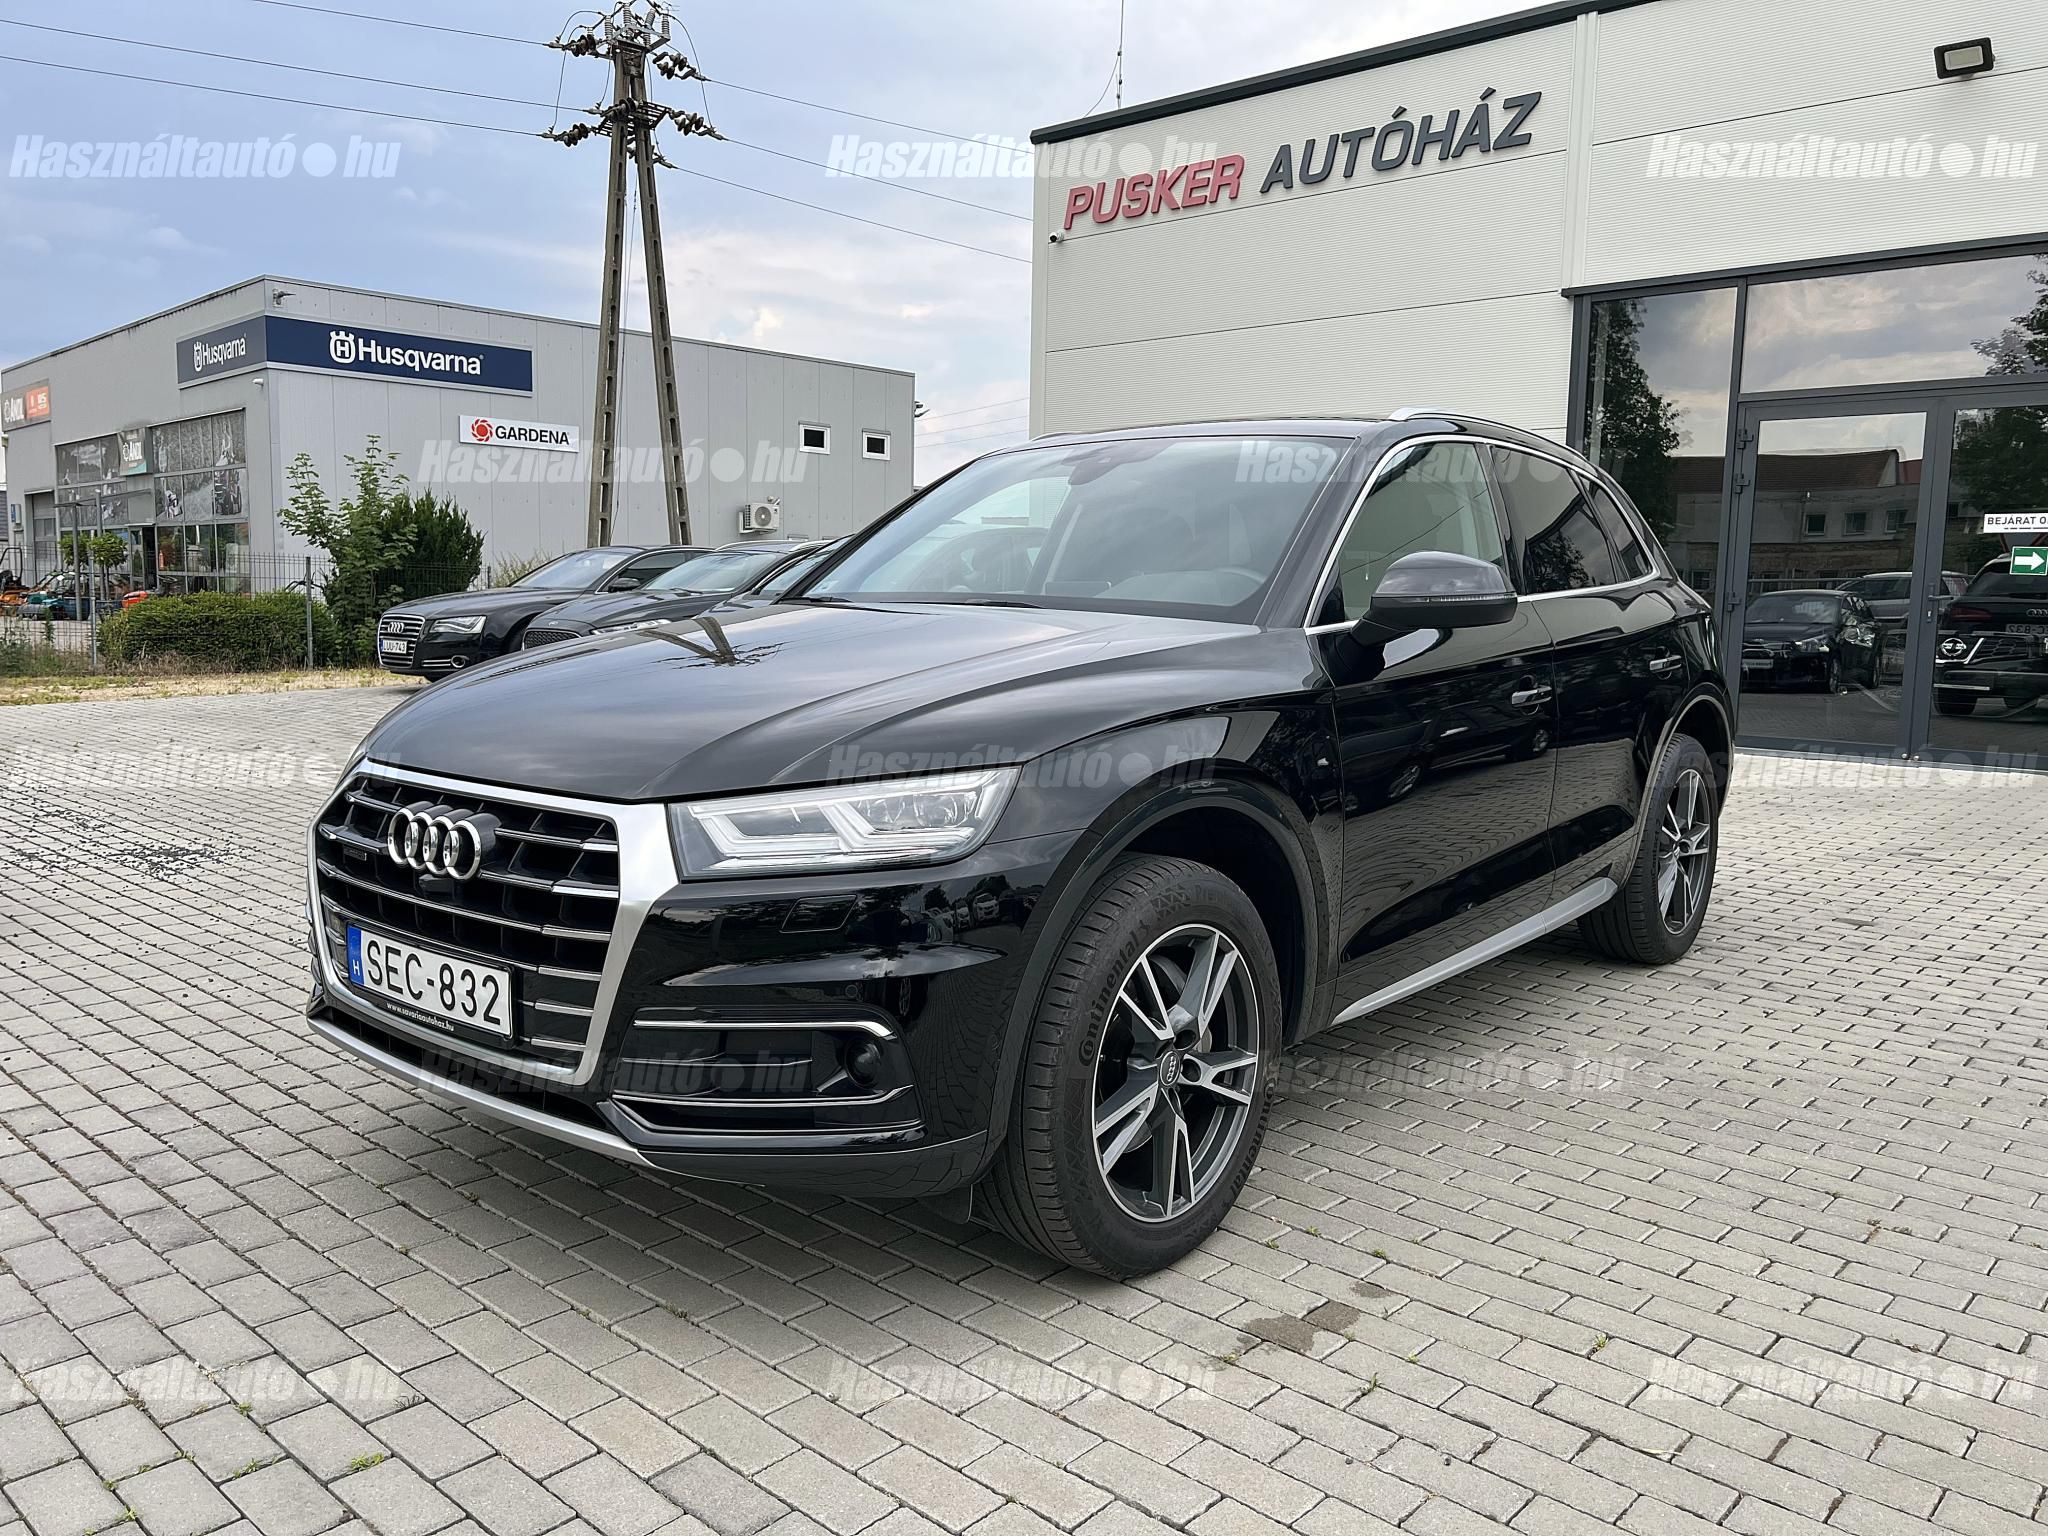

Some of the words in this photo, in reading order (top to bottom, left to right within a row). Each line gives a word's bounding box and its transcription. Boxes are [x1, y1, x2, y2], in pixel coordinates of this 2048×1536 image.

[1063, 153, 1245, 230] PUSKER
[1260, 87, 1542, 193] AUTÓHÁZ
[203, 335, 246, 366] Husqvarna
[358, 338, 482, 375] Husqvarna
[495, 425, 570, 446] GARDENA
[1987, 514, 2036, 525] BEJÁRAT
[352, 960, 361, 976] H
[367, 939, 501, 1026] SEC-832
[1078, 930, 1142, 1066] Continental
